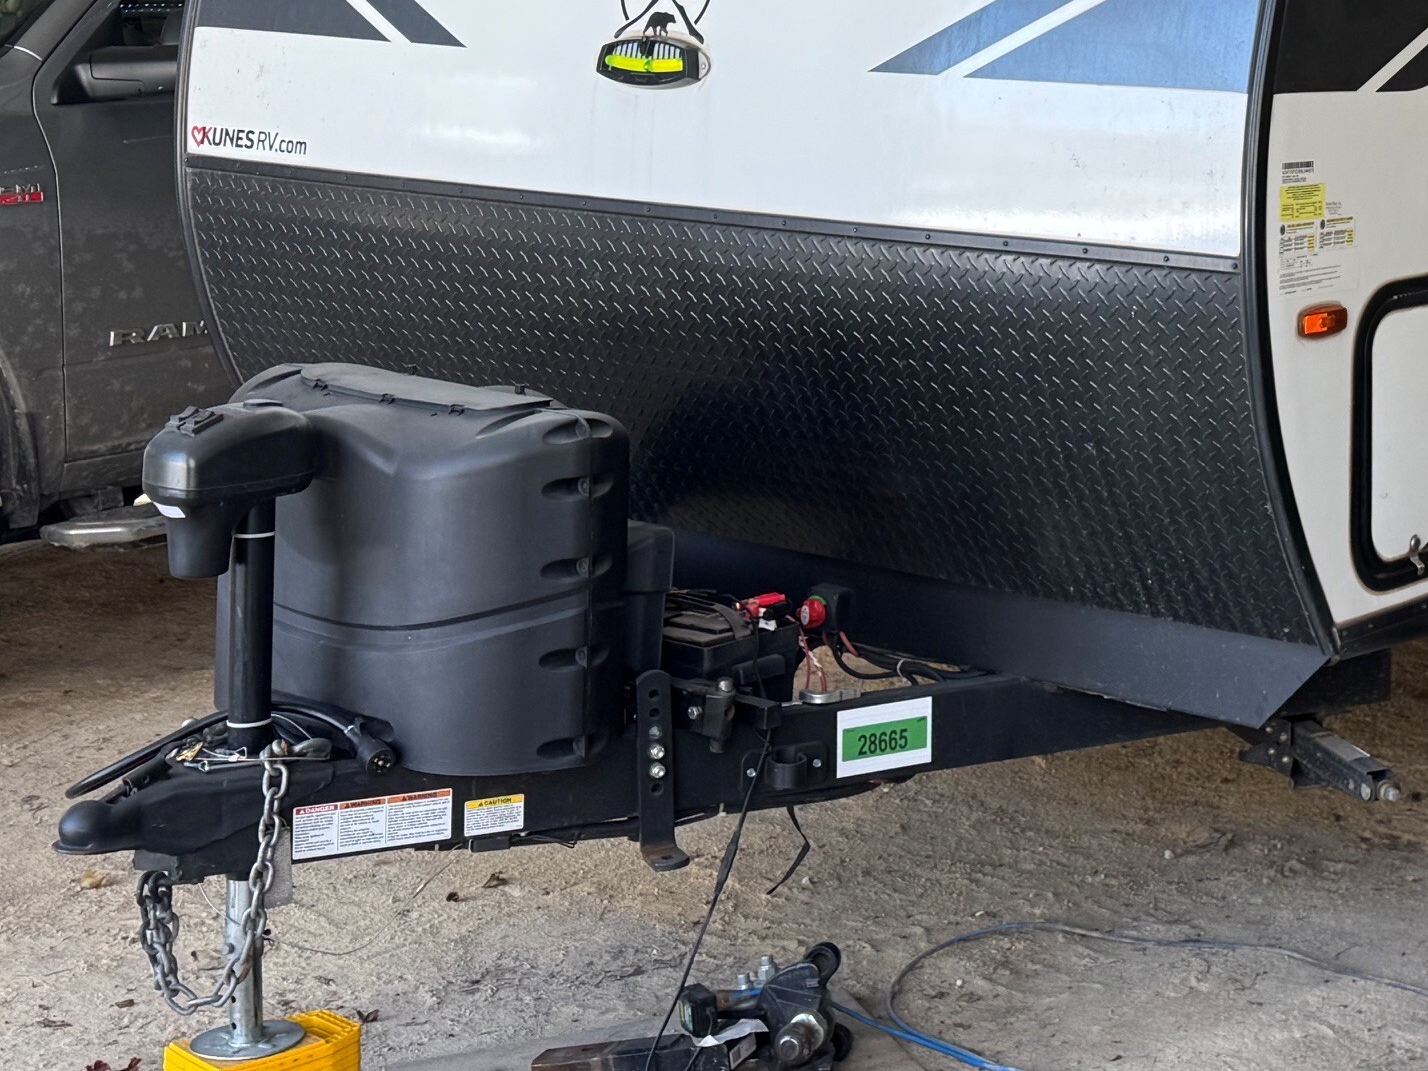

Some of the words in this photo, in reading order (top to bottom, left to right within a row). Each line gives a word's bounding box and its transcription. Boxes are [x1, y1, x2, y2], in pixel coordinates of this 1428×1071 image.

[857, 728, 909, 757] 28665
[406, 792, 438, 801] WARNING
[483, 797, 512, 806] CAUTION
[305, 805, 335, 814] DANGER
